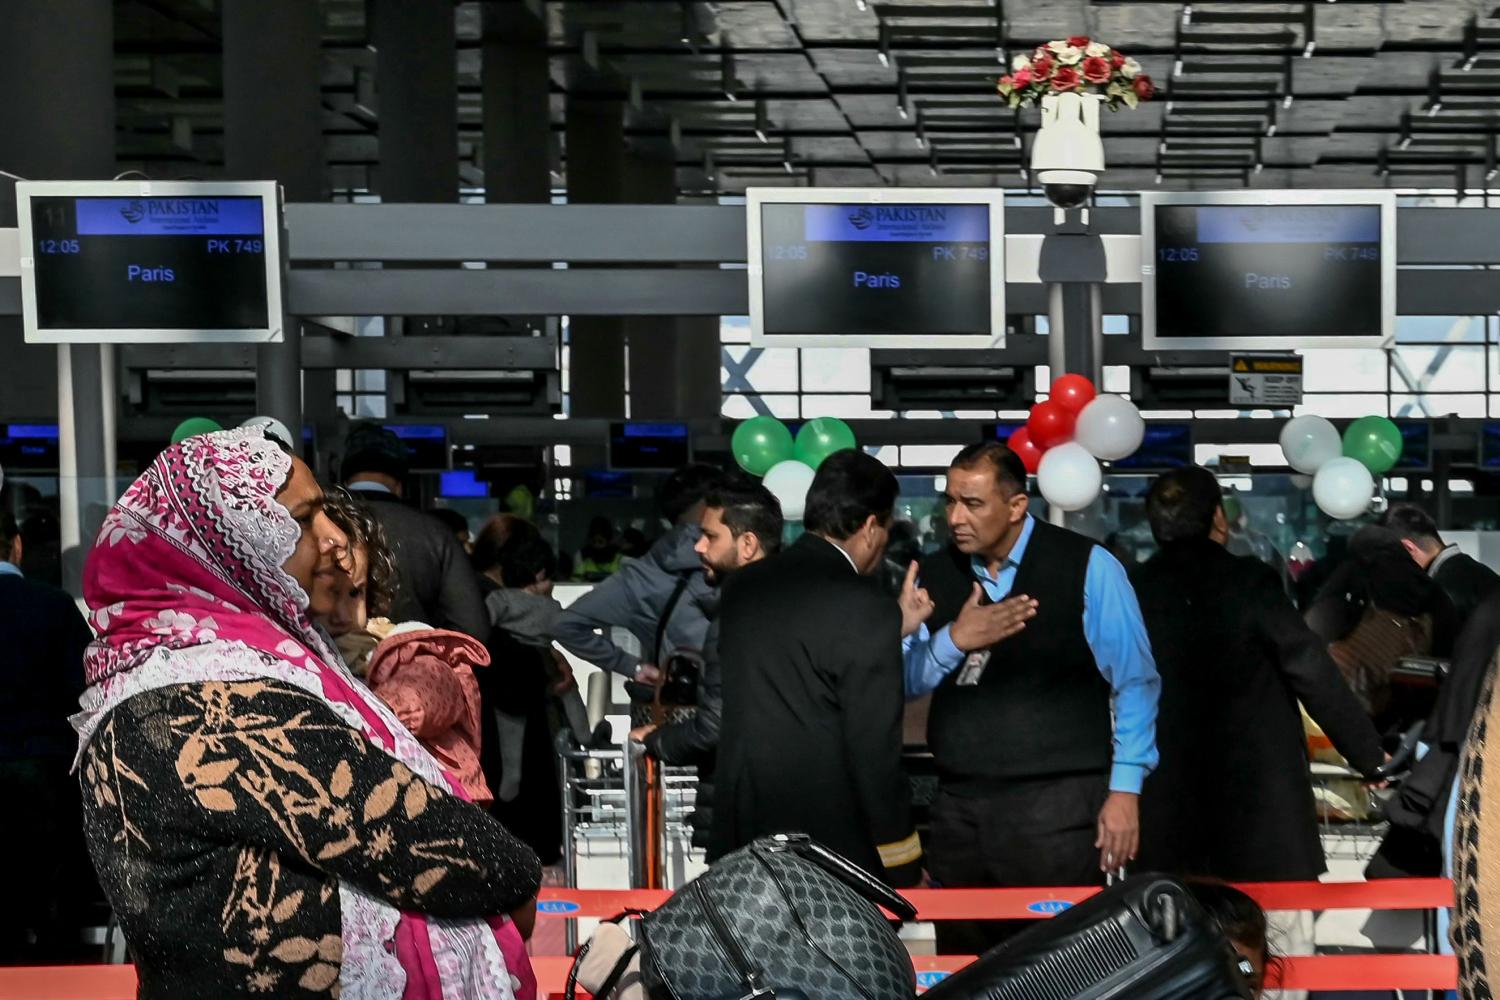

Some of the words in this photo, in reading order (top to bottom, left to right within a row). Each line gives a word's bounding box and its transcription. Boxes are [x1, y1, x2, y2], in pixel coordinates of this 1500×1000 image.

[149, 200, 219, 215] PAKISTAN
[876, 207, 947, 222] PAKISTAN
[39, 240, 80, 254] 12:05
[207, 240, 231, 254] PK
[235, 240, 263, 254] 749
[933, 246, 956, 261] PK
[960, 246, 987, 260] 749
[1323, 247, 1346, 261] PK
[1160, 248, 1199, 262] 12:05
[127, 264, 175, 282] Paris
[853, 271, 901, 289] Paris
[1244, 272, 1292, 289] Paris
